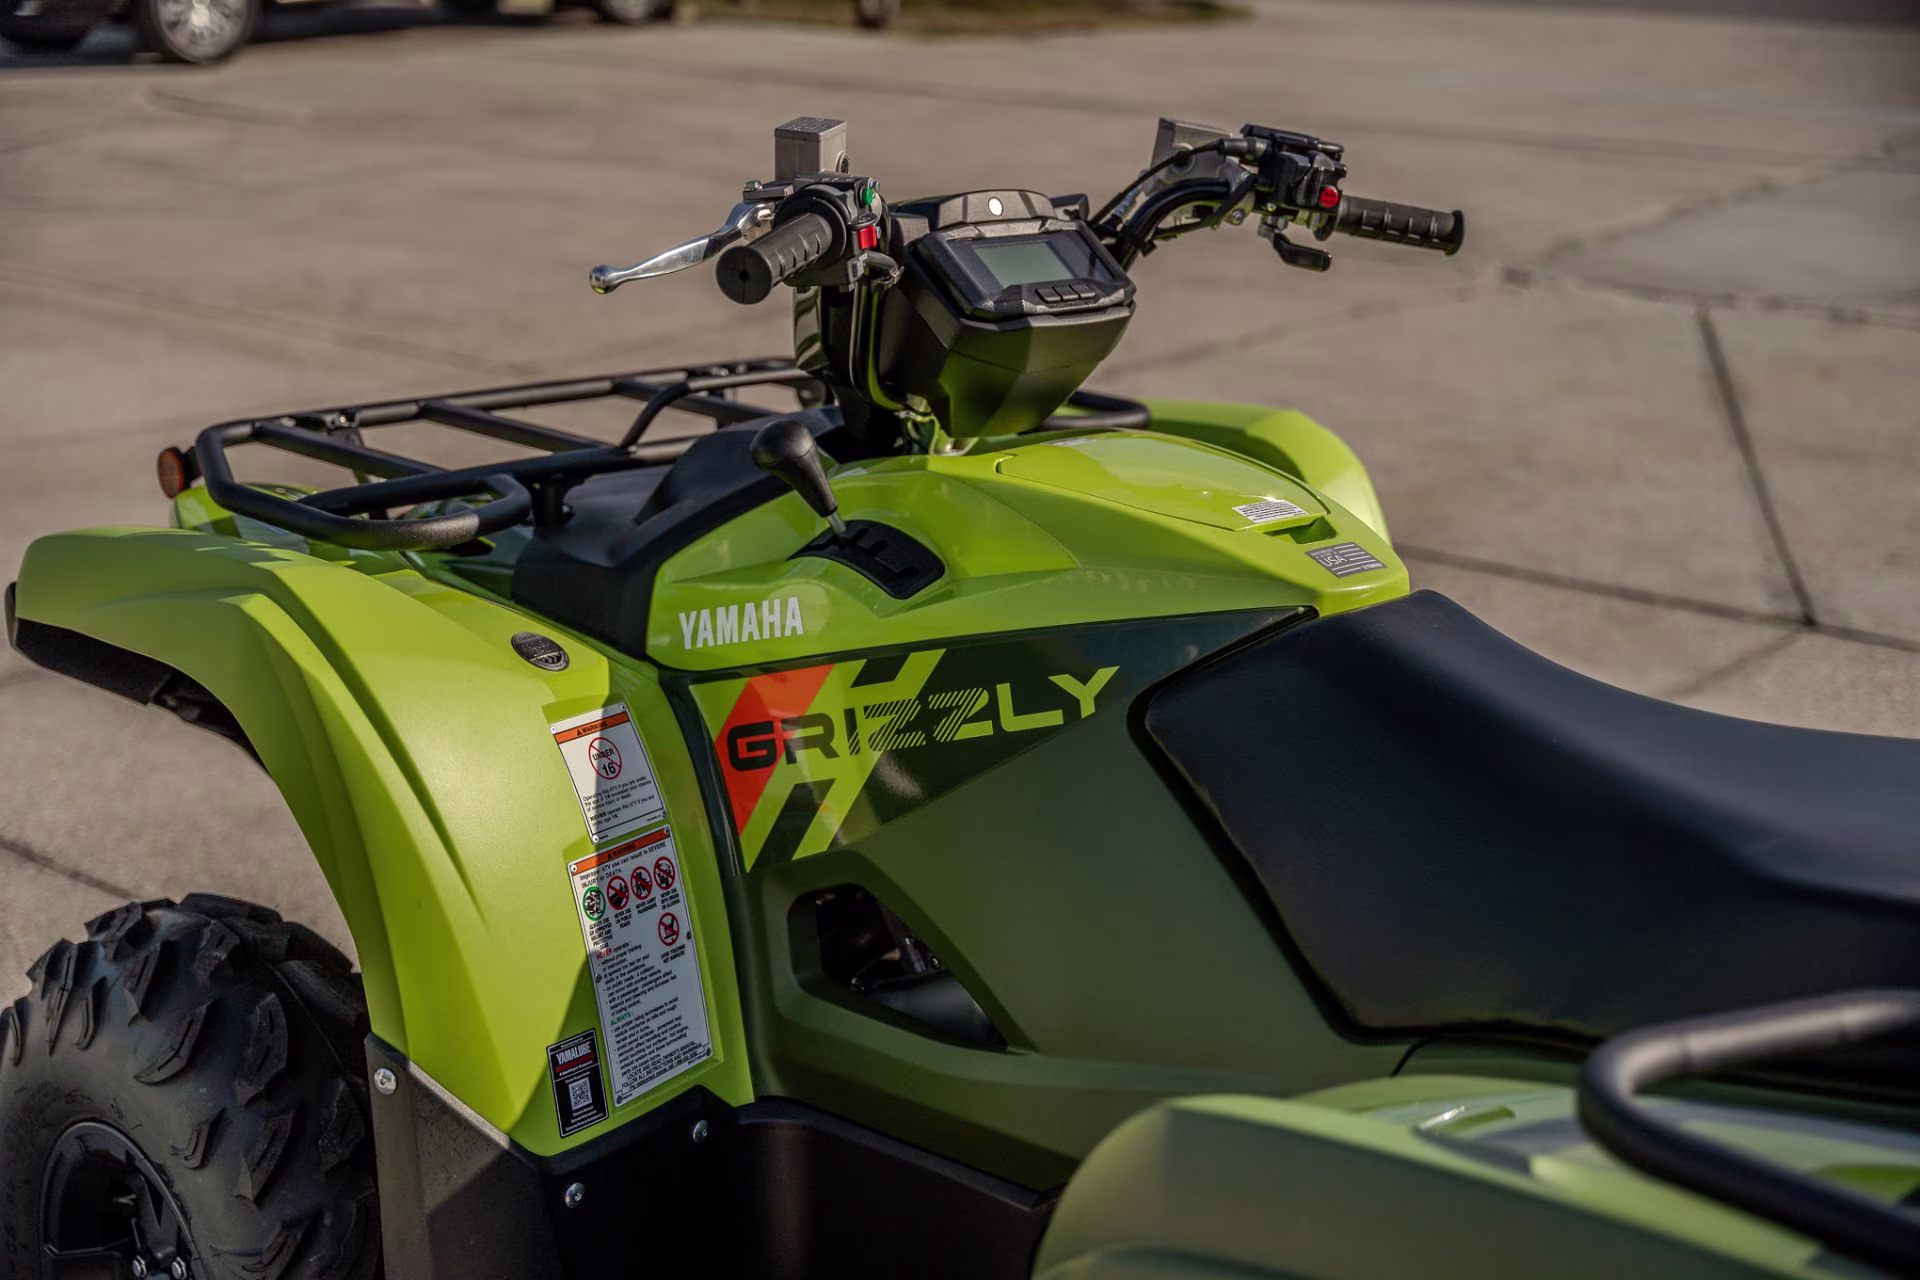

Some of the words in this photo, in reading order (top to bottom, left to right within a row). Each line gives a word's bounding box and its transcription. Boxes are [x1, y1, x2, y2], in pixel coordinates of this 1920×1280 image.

[1319, 555, 1347, 567] USA
[679, 596, 804, 650] YAMAHA
[727, 666, 1120, 771] GRIZZLY
[602, 763, 616, 776] 16
[590, 812, 607, 822] NEVER
[611, 1012, 631, 1026] ALWAYS
[556, 1041, 591, 1064] YAMALUBE
